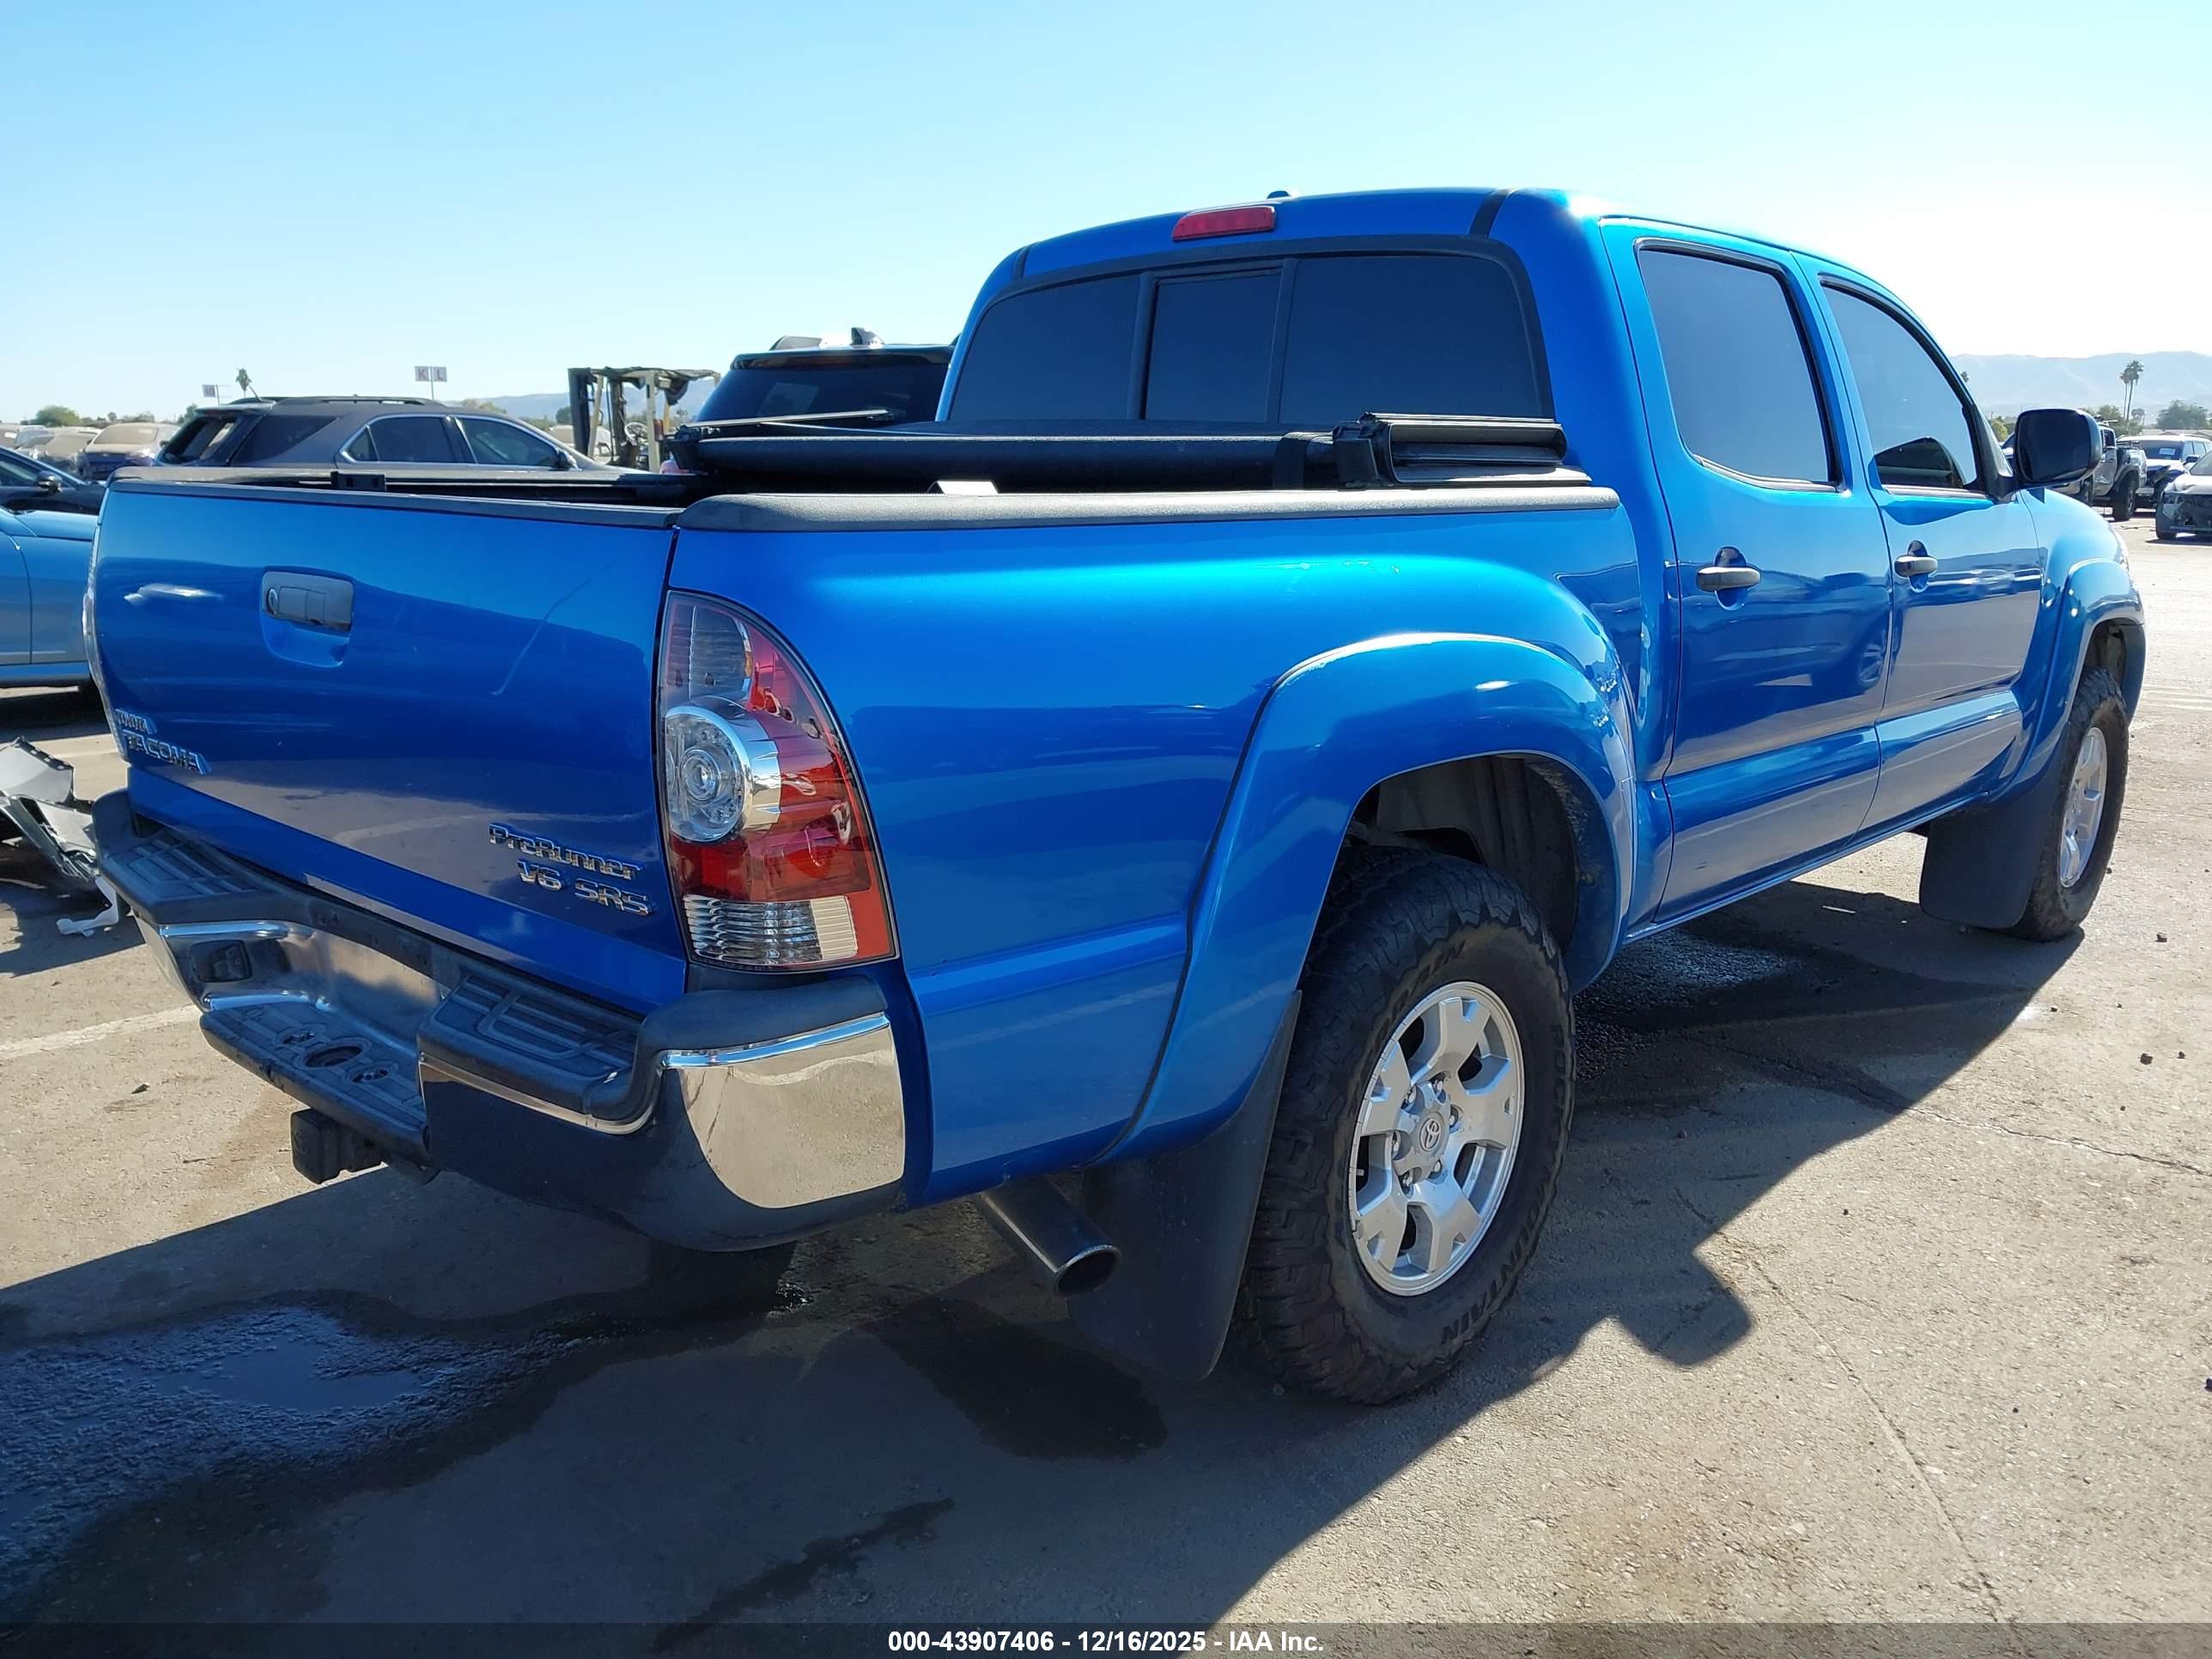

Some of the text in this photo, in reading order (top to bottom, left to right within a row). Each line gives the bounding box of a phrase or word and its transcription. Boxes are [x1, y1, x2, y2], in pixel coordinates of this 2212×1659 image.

[417, 368, 428, 380] K
[436, 369, 445, 380] L
[122, 729, 211, 775] TACOMA
[488, 822, 644, 881] PreRunner
[516, 859, 652, 917] V6 SR5
